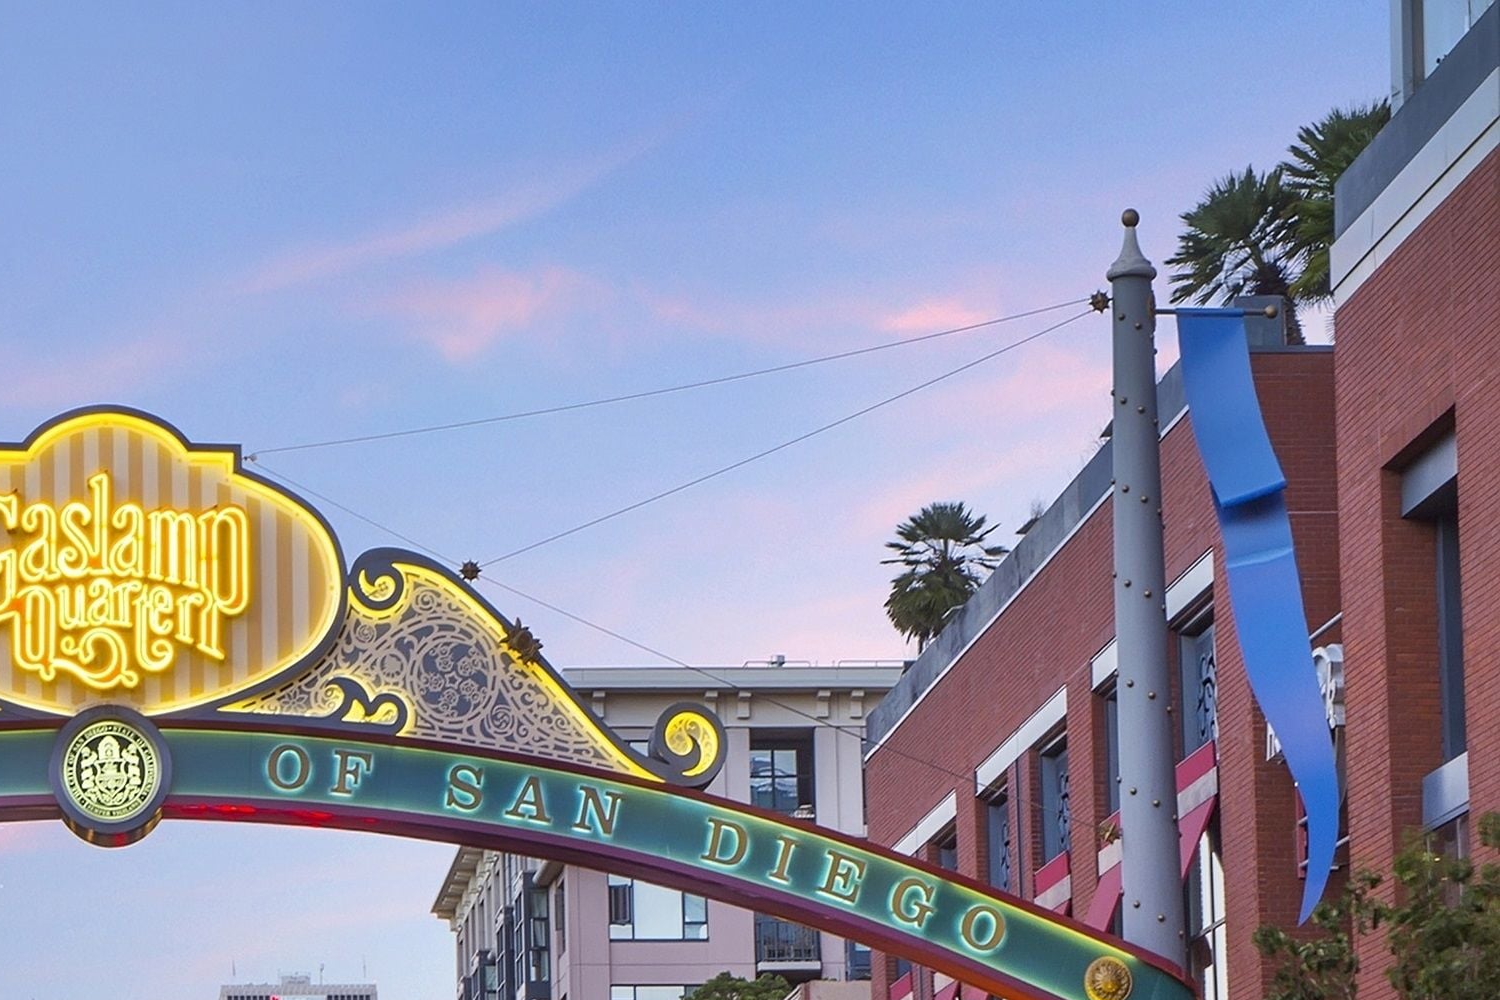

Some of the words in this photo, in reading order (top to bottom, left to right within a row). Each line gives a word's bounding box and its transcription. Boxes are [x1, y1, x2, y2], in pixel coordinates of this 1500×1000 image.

[12, 576, 226, 690] Quarter
[266, 744, 373, 796] OF
[446, 764, 623, 836] SAN
[700, 816, 1007, 952] DIEGO
